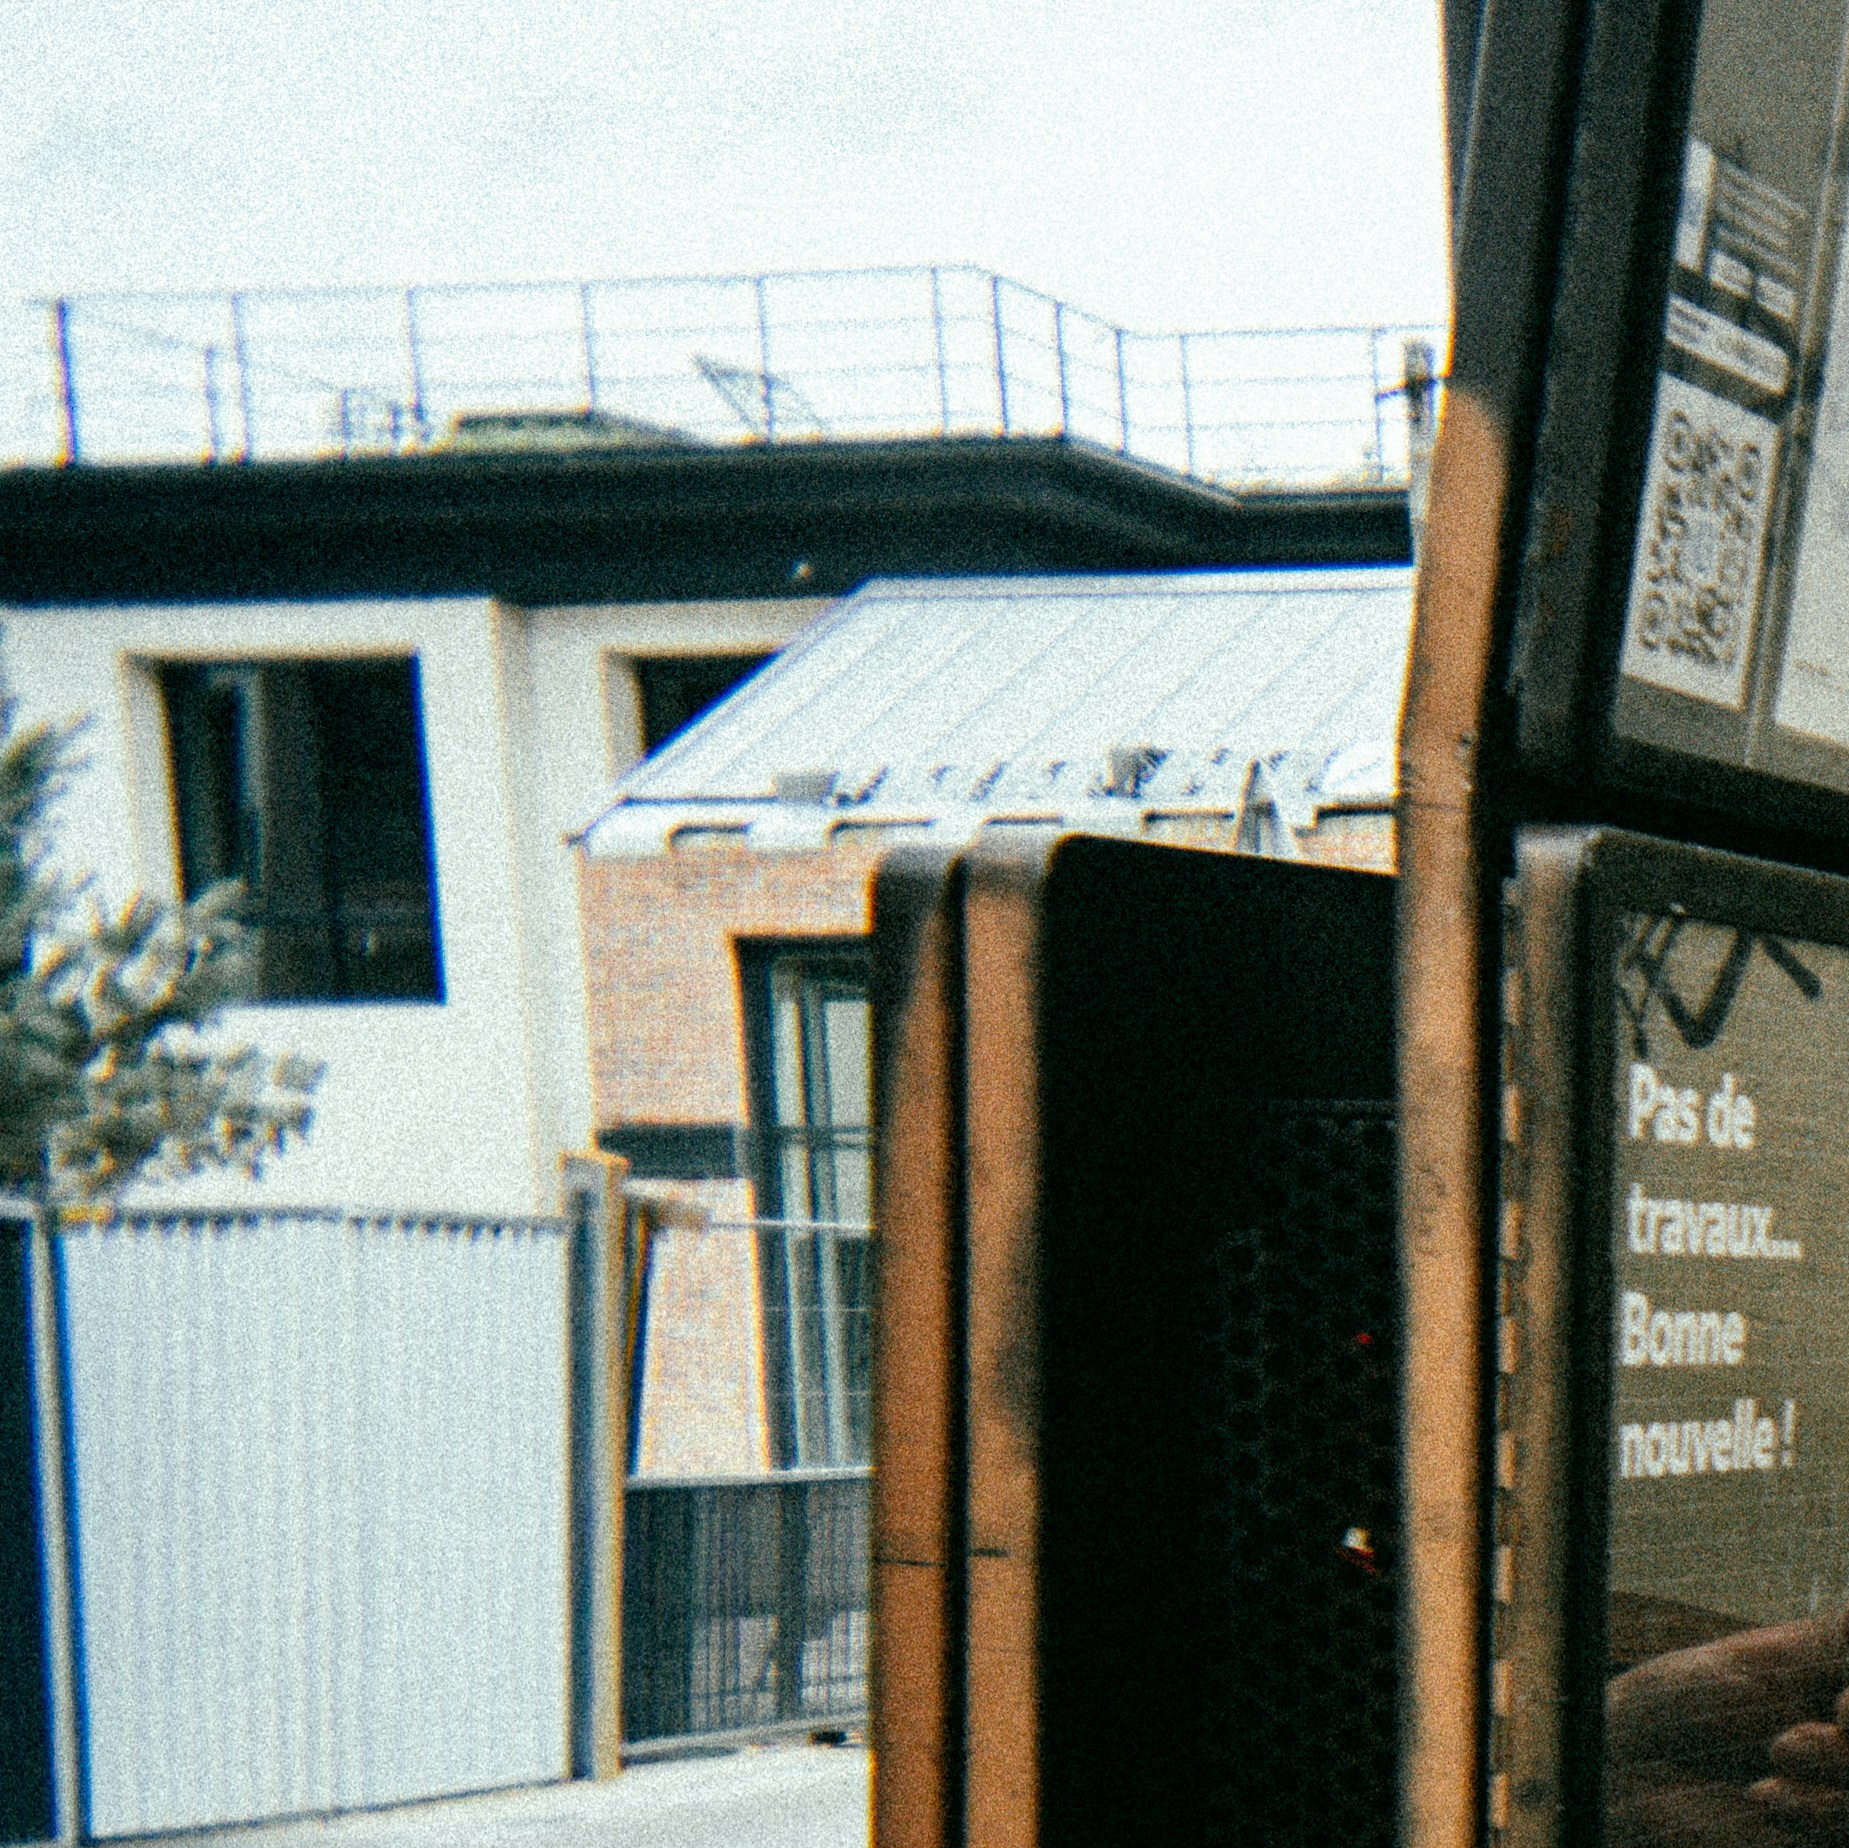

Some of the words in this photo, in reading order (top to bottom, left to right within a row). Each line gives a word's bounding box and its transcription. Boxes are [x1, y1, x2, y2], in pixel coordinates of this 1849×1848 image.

[1627, 1062, 1700, 1144] Pas
[1706, 1072, 1756, 1149] de
[1626, 1182, 1802, 1260] travaux...
[1620, 1291, 1747, 1367] Bonne
[1618, 1398, 1777, 1478] nouvelle
